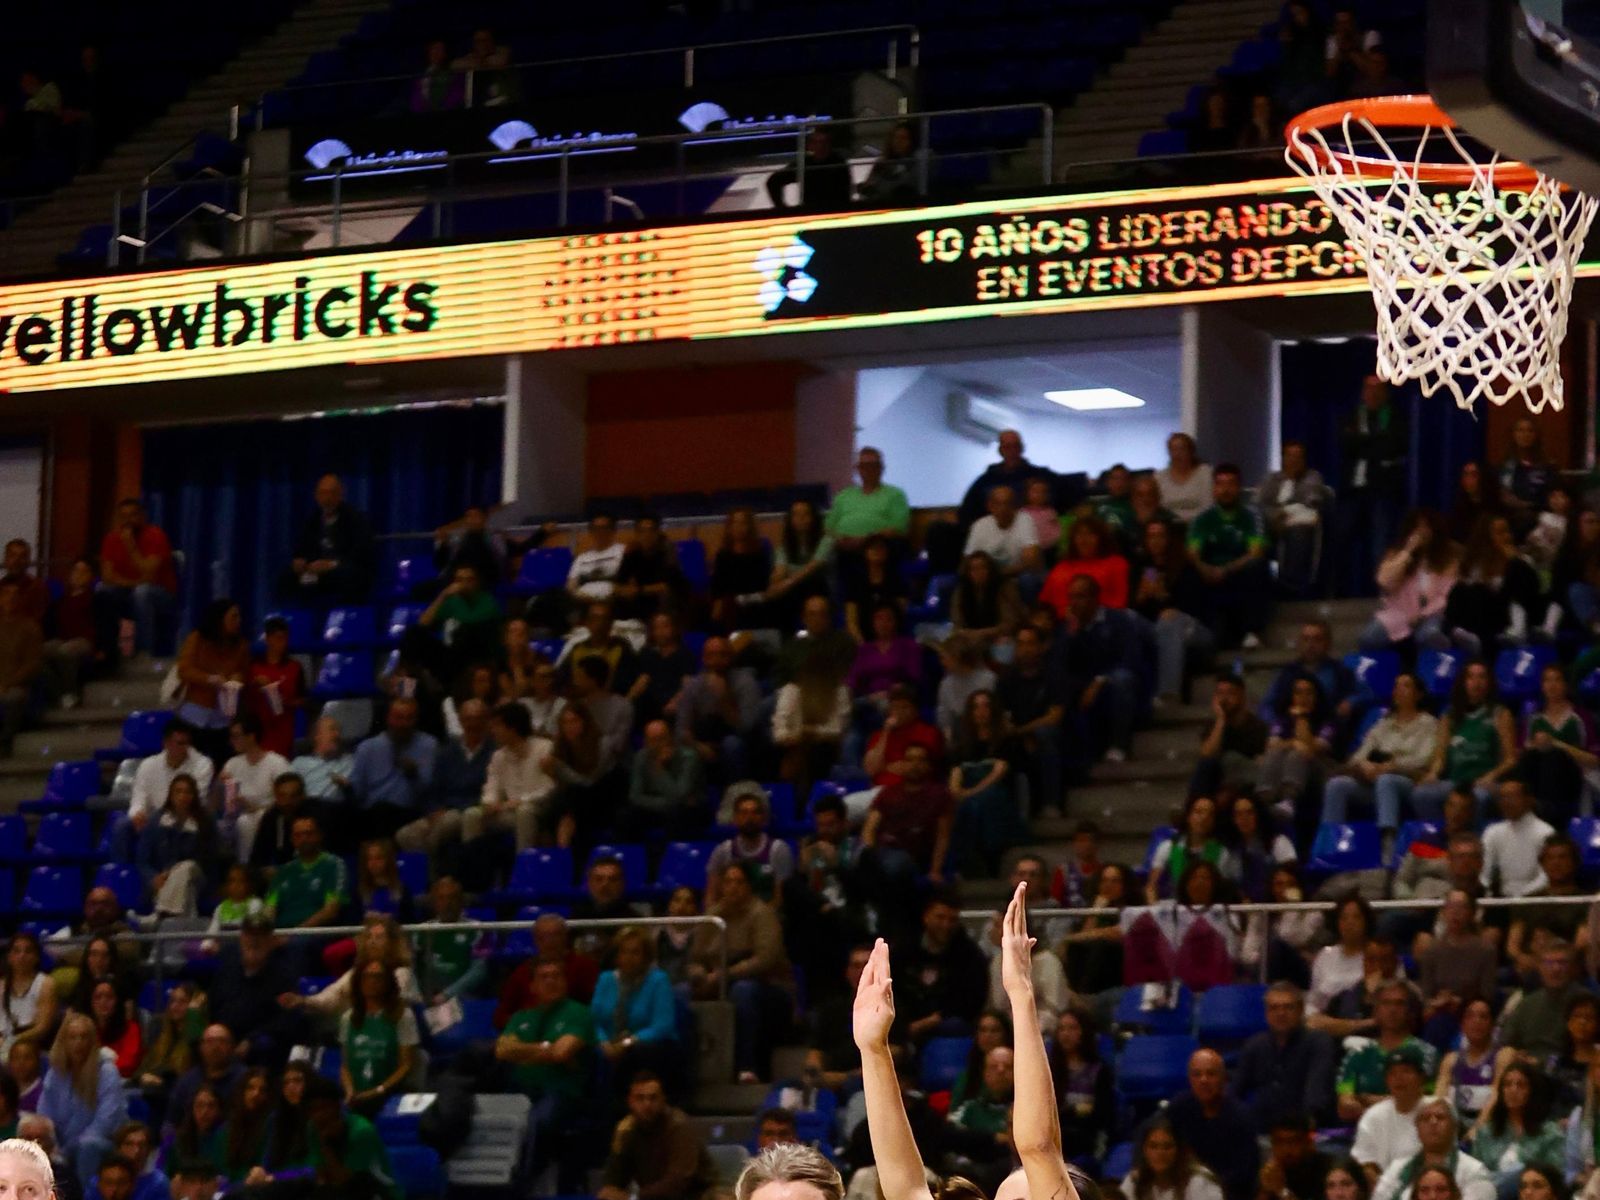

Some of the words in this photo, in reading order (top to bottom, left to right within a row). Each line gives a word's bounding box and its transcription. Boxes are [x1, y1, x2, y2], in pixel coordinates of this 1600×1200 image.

[917, 226, 964, 264] 10
[970, 215, 1092, 259] AÑOS
[1099, 199, 1333, 250] LIDERANDO
[977, 265, 1029, 300] EN
[1038, 248, 1224, 297] EVENTOS
